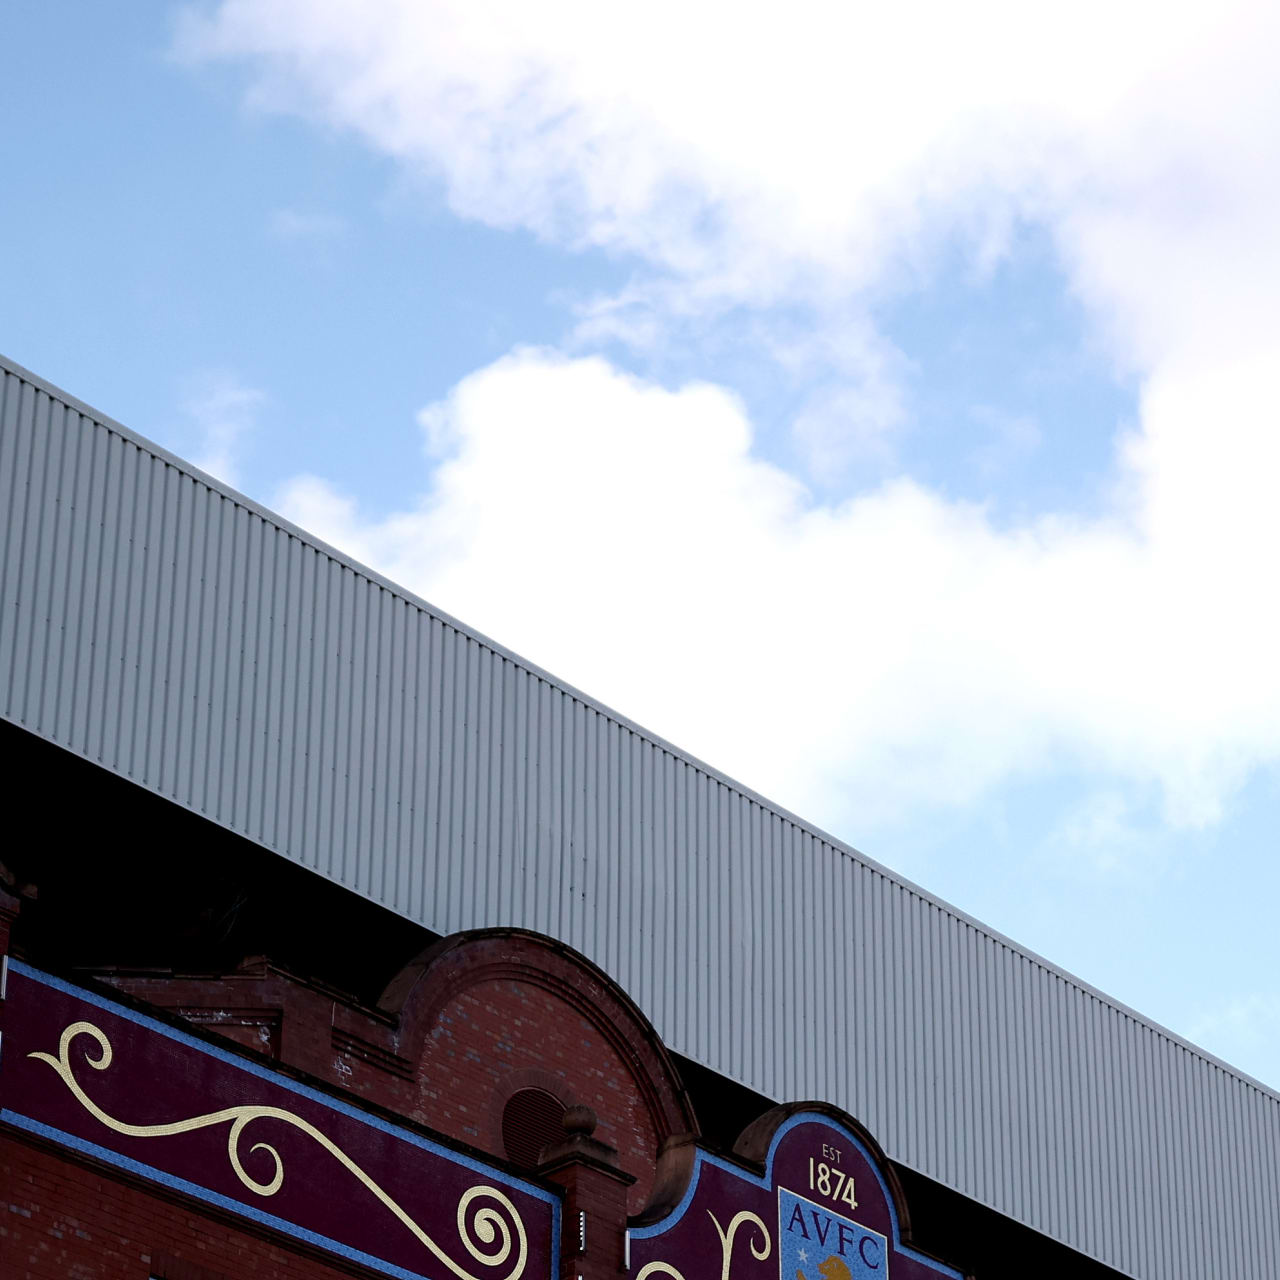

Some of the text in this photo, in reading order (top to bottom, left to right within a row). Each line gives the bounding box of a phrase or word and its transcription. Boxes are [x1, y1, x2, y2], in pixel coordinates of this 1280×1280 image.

[822, 1143, 841, 1163] EST
[809, 1157, 858, 1210] 1874
[786, 1202, 880, 1270] AVFC
